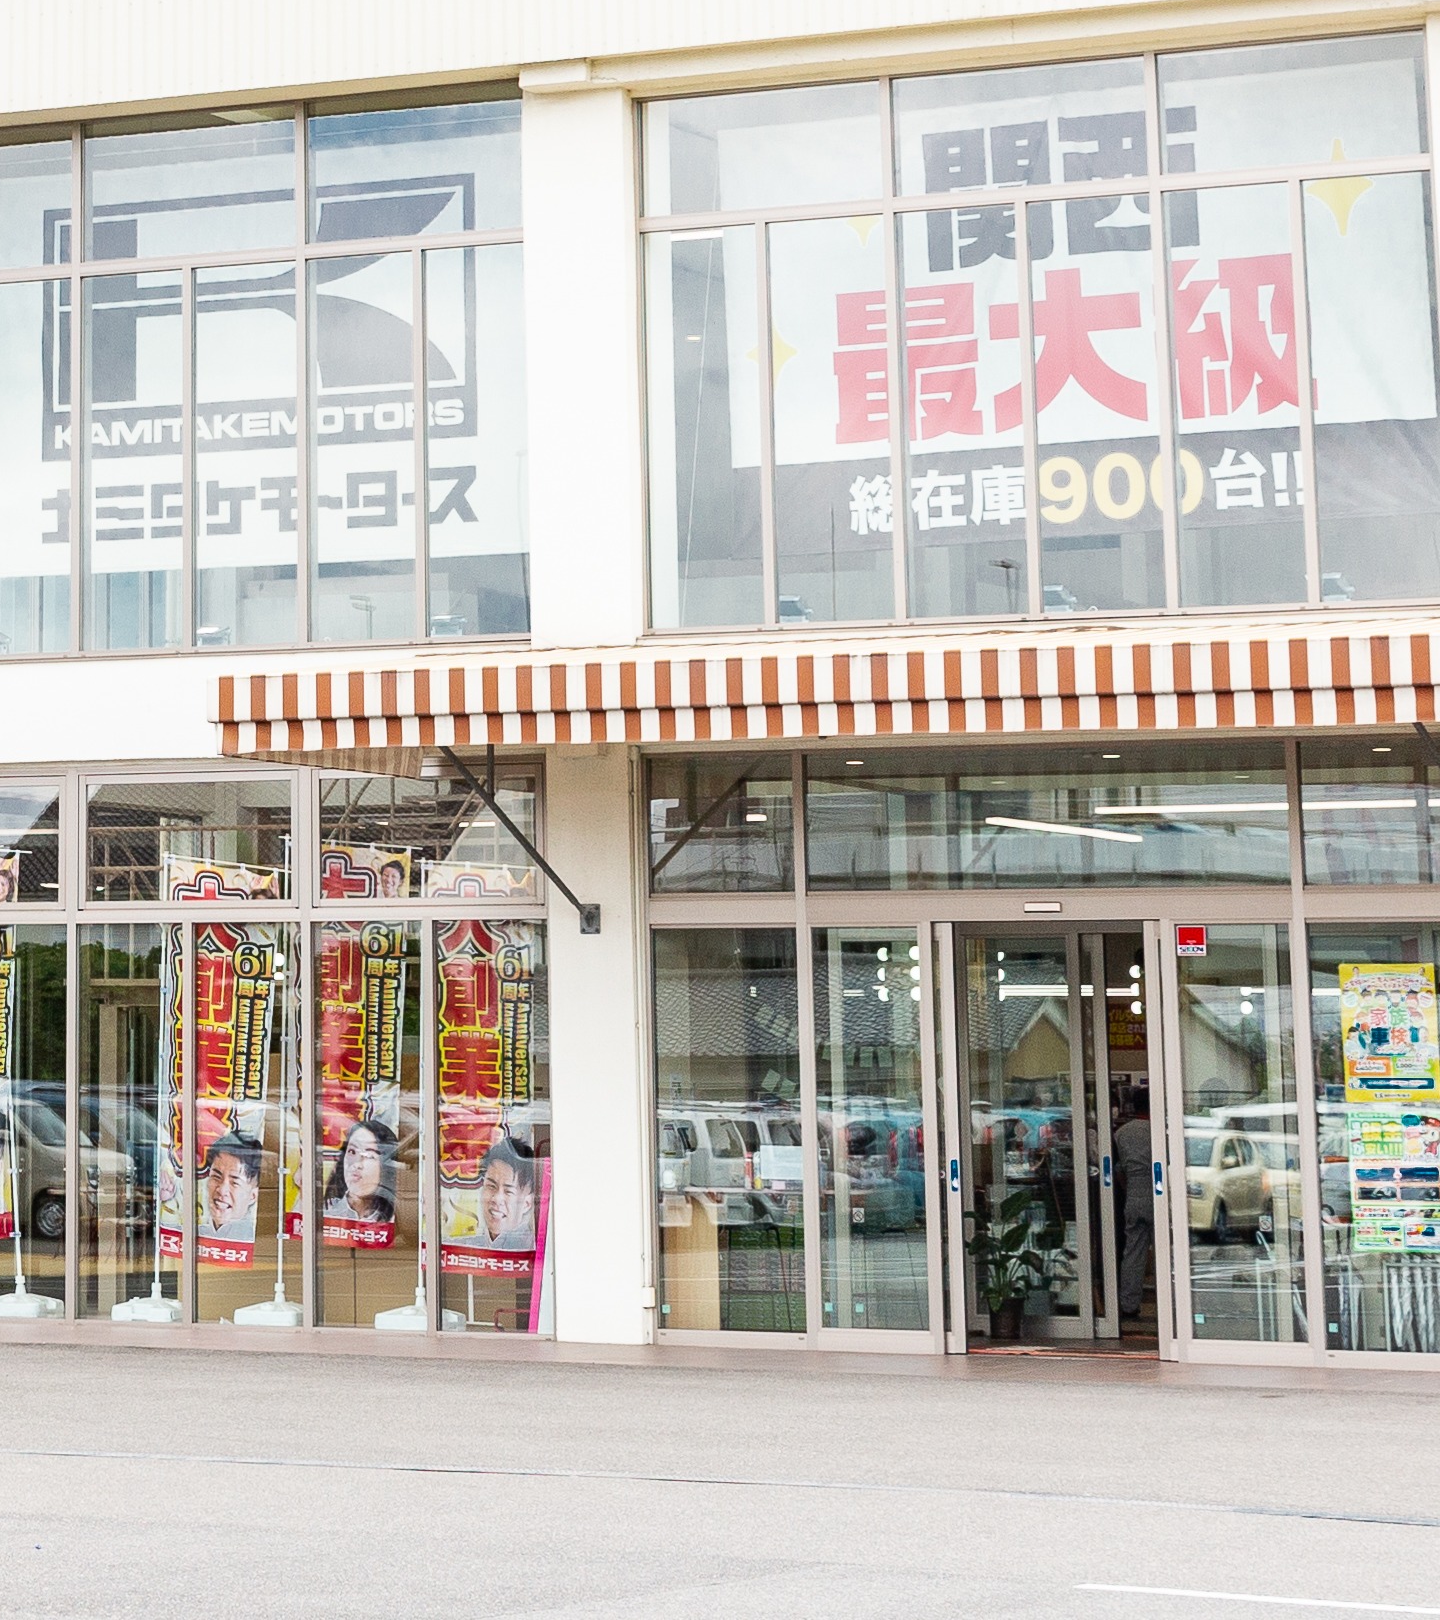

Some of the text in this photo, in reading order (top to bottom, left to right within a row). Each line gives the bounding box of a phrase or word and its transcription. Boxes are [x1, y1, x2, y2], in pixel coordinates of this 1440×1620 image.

[921, 105, 1200, 273] 関西
[833, 253, 1319, 445] 最大級
[234, 943, 275, 979] 61
[361, 921, 405, 957] 61
[495, 944, 533, 980] 61
[246, 998, 268, 1099] Anniversary
[379, 978, 399, 1077] Anniversary
[1370, 1026, 1409, 1046] 車検
